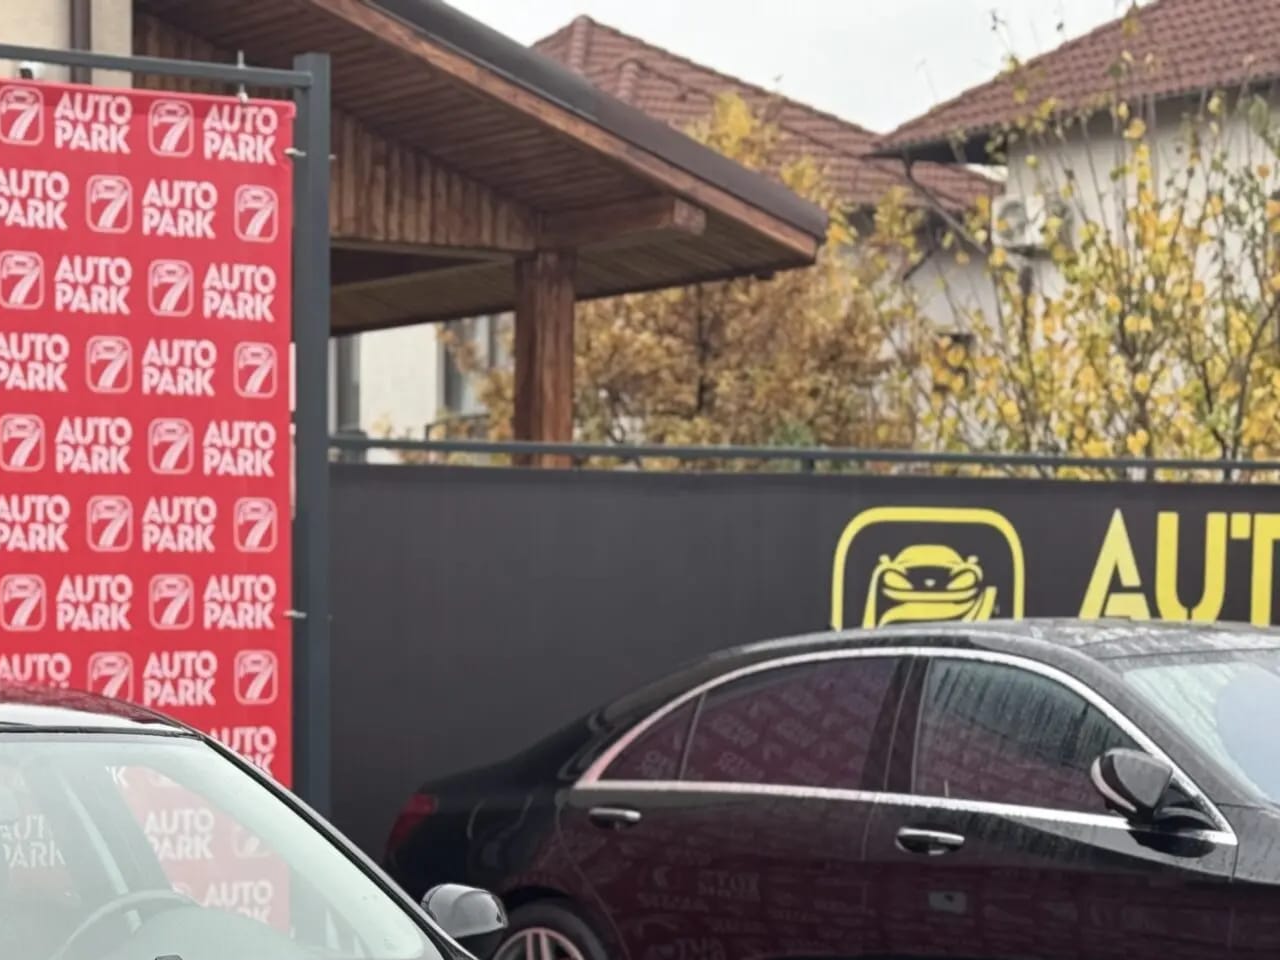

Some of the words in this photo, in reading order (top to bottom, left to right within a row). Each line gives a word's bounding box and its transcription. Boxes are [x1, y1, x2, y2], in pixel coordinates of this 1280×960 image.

[54, 93, 131, 124] AUTO
[203, 106, 277, 136] AUTO
[54, 119, 131, 153] PARK
[204, 131, 275, 164] PARK
[143, 180, 217, 211] AUTO
[143, 206, 217, 238] PARK
[55, 256, 132, 288] AUTO
[203, 264, 276, 295] AUTO
[55, 283, 130, 314] PARK
[204, 290, 275, 321] PARK
[142, 339, 216, 370] AUTO
[142, 365, 216, 396] PARK
[55, 417, 132, 448] AUTO
[203, 421, 276, 451] AUTO
[55, 443, 130, 473] PARK
[203, 447, 274, 476] PARK
[143, 497, 216, 527] AUTO
[143, 523, 214, 552] PARK
[56, 575, 132, 606] AUTO
[204, 575, 276, 605] AUTO
[56, 602, 130, 630] PARK
[204, 601, 274, 629] PARK
[143, 651, 217, 680] AUTO
[143, 677, 215, 709] PARK
[144, 808, 214, 836] AUTO
